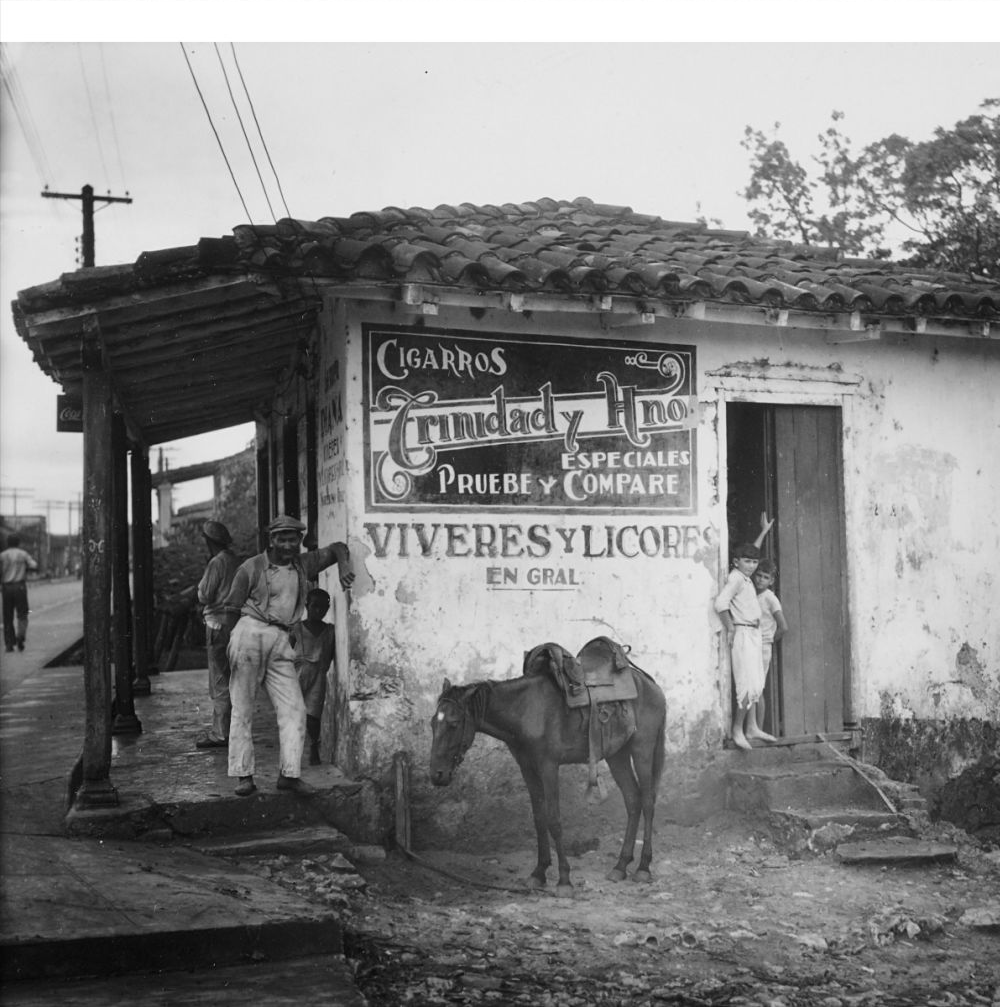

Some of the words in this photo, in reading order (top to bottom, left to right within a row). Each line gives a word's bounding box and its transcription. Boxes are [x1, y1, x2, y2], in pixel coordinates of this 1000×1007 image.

[376, 338, 507, 380] CIGARROS
[375, 382, 559, 477] Trinidad
[559, 409, 584, 454] y
[596, 370, 688, 448] Hno
[561, 451, 690, 470] ESPECIALES
[437, 464, 532, 494] PRUEBE
[563, 470, 679, 501] COMPARE
[363, 522, 553, 559] VIVERES
[555, 527, 577, 554] Y
[486, 567, 518, 585] EN
